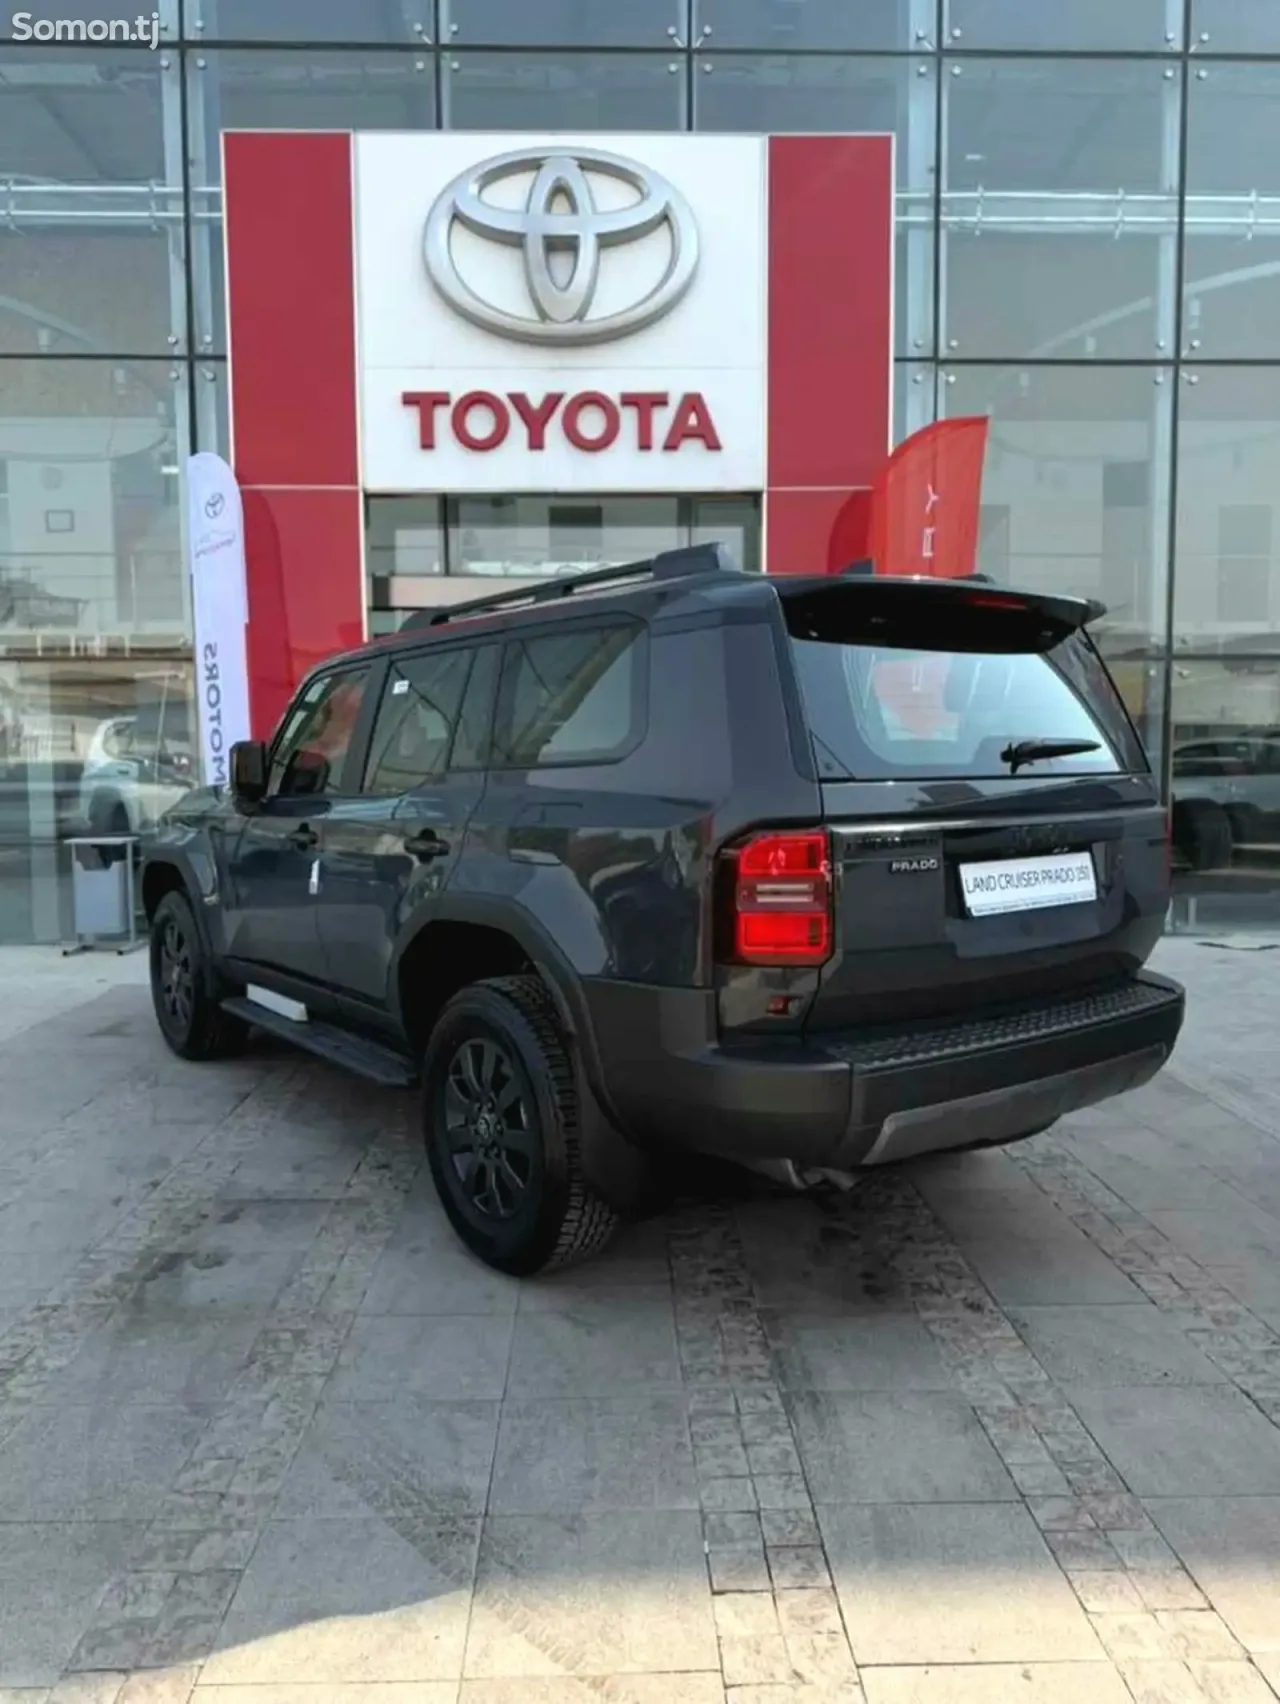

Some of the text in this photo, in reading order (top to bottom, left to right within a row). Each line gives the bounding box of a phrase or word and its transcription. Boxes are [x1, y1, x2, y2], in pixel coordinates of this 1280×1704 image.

[402, 390, 722, 453] TOYOTA
[891, 859, 938, 871] PRADO
[965, 875, 996, 893] LAND
[998, 871, 1039, 890] CRUISER
[1041, 867, 1075, 884] PRADO
